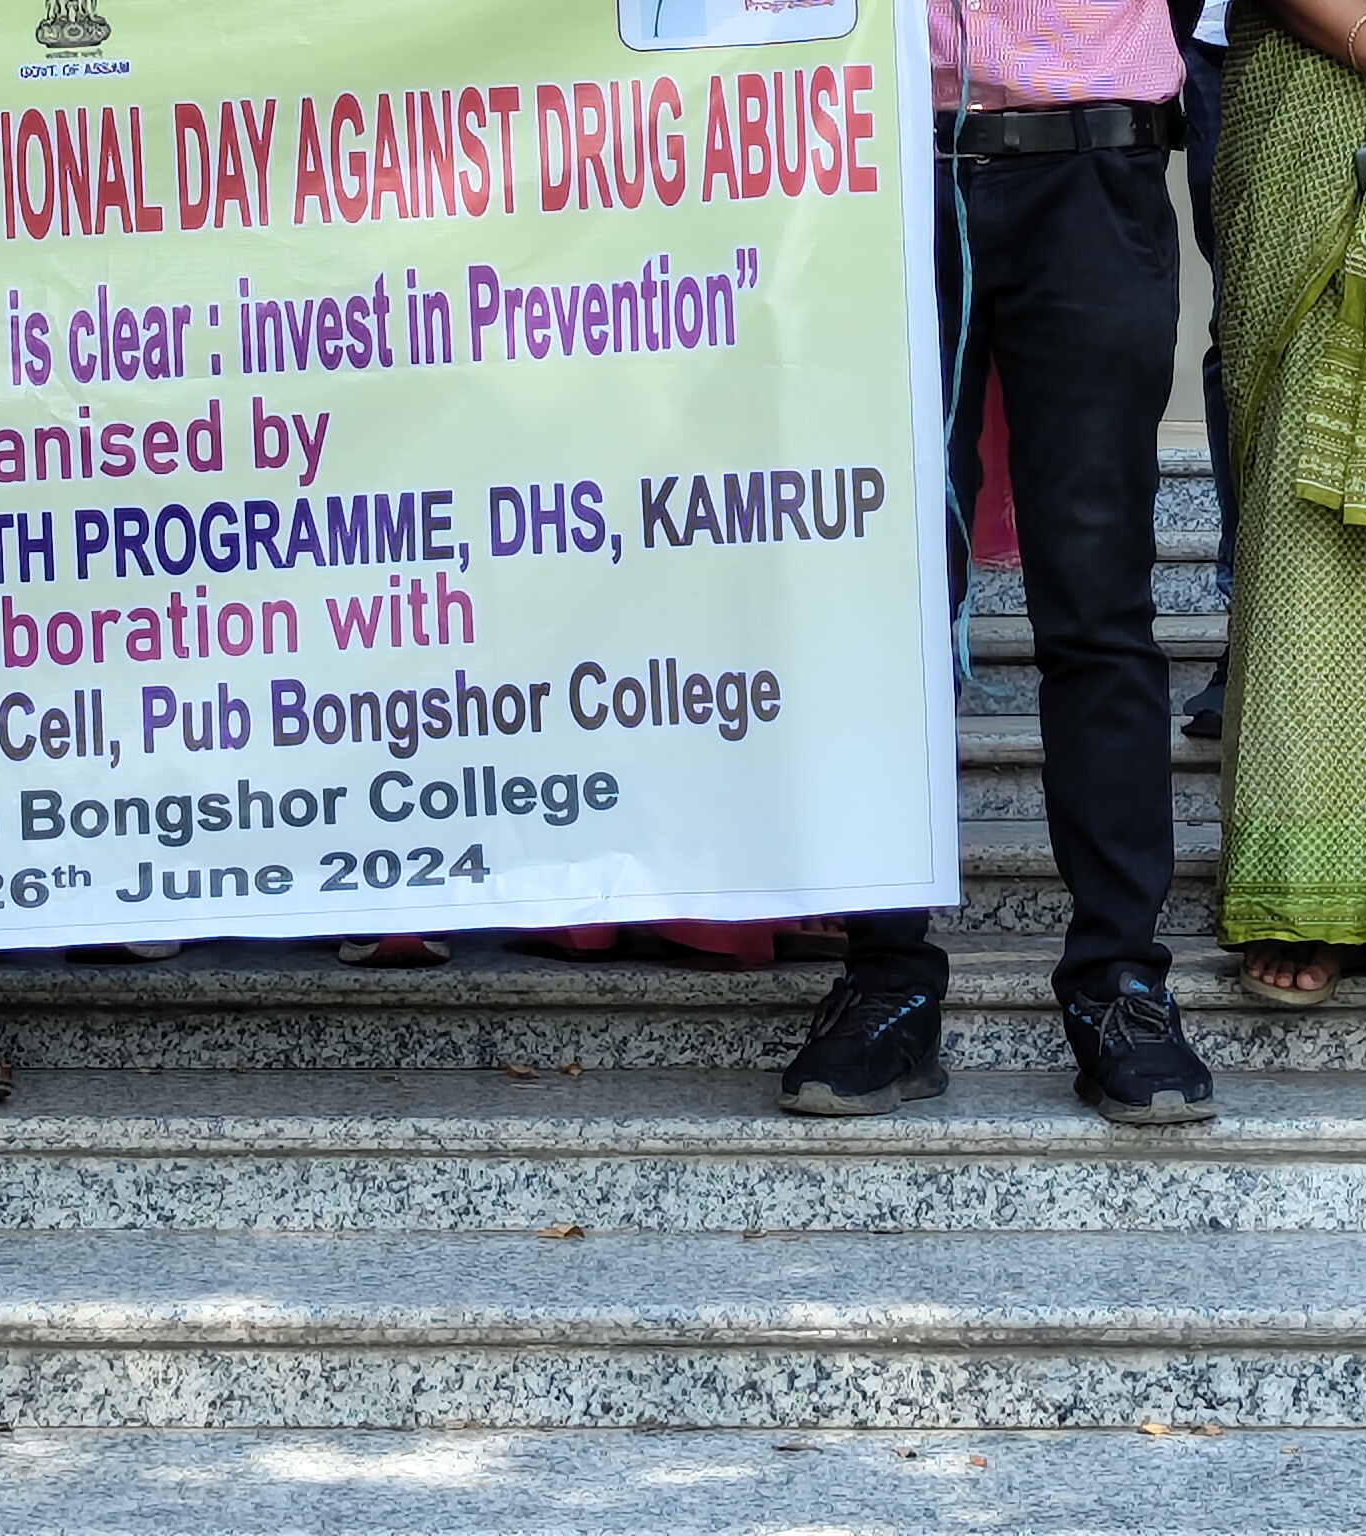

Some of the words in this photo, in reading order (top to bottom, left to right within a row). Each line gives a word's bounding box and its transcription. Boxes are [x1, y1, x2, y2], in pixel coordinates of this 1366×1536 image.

[175, 99, 277, 231] DAY
[293, 84, 520, 224] AGAINST
[537, 76, 685, 213] DRUG
[702, 64, 878, 202] ABUSE
[10, 290, 51, 387] is
[68, 284, 191, 383] clear
[238, 272, 393, 374] invest
[407, 268, 452, 365] in
[468, 247, 758, 364] Prevention”
[252, 396, 331, 487] by
[75, 490, 470, 580] PROGRAMME,
[489, 479, 623, 564] DHS,
[641, 467, 885, 550] KAMRUP
[325, 570, 475, 650] with
[142, 682, 251, 755] Pub
[272, 669, 551, 759] Bongshor
[569, 657, 782, 742] College
[20, 779, 348, 847] Bongshor
[369, 765, 620, 826] College
[115, 860, 295, 904] June
[318, 843, 492, 892] 2024
